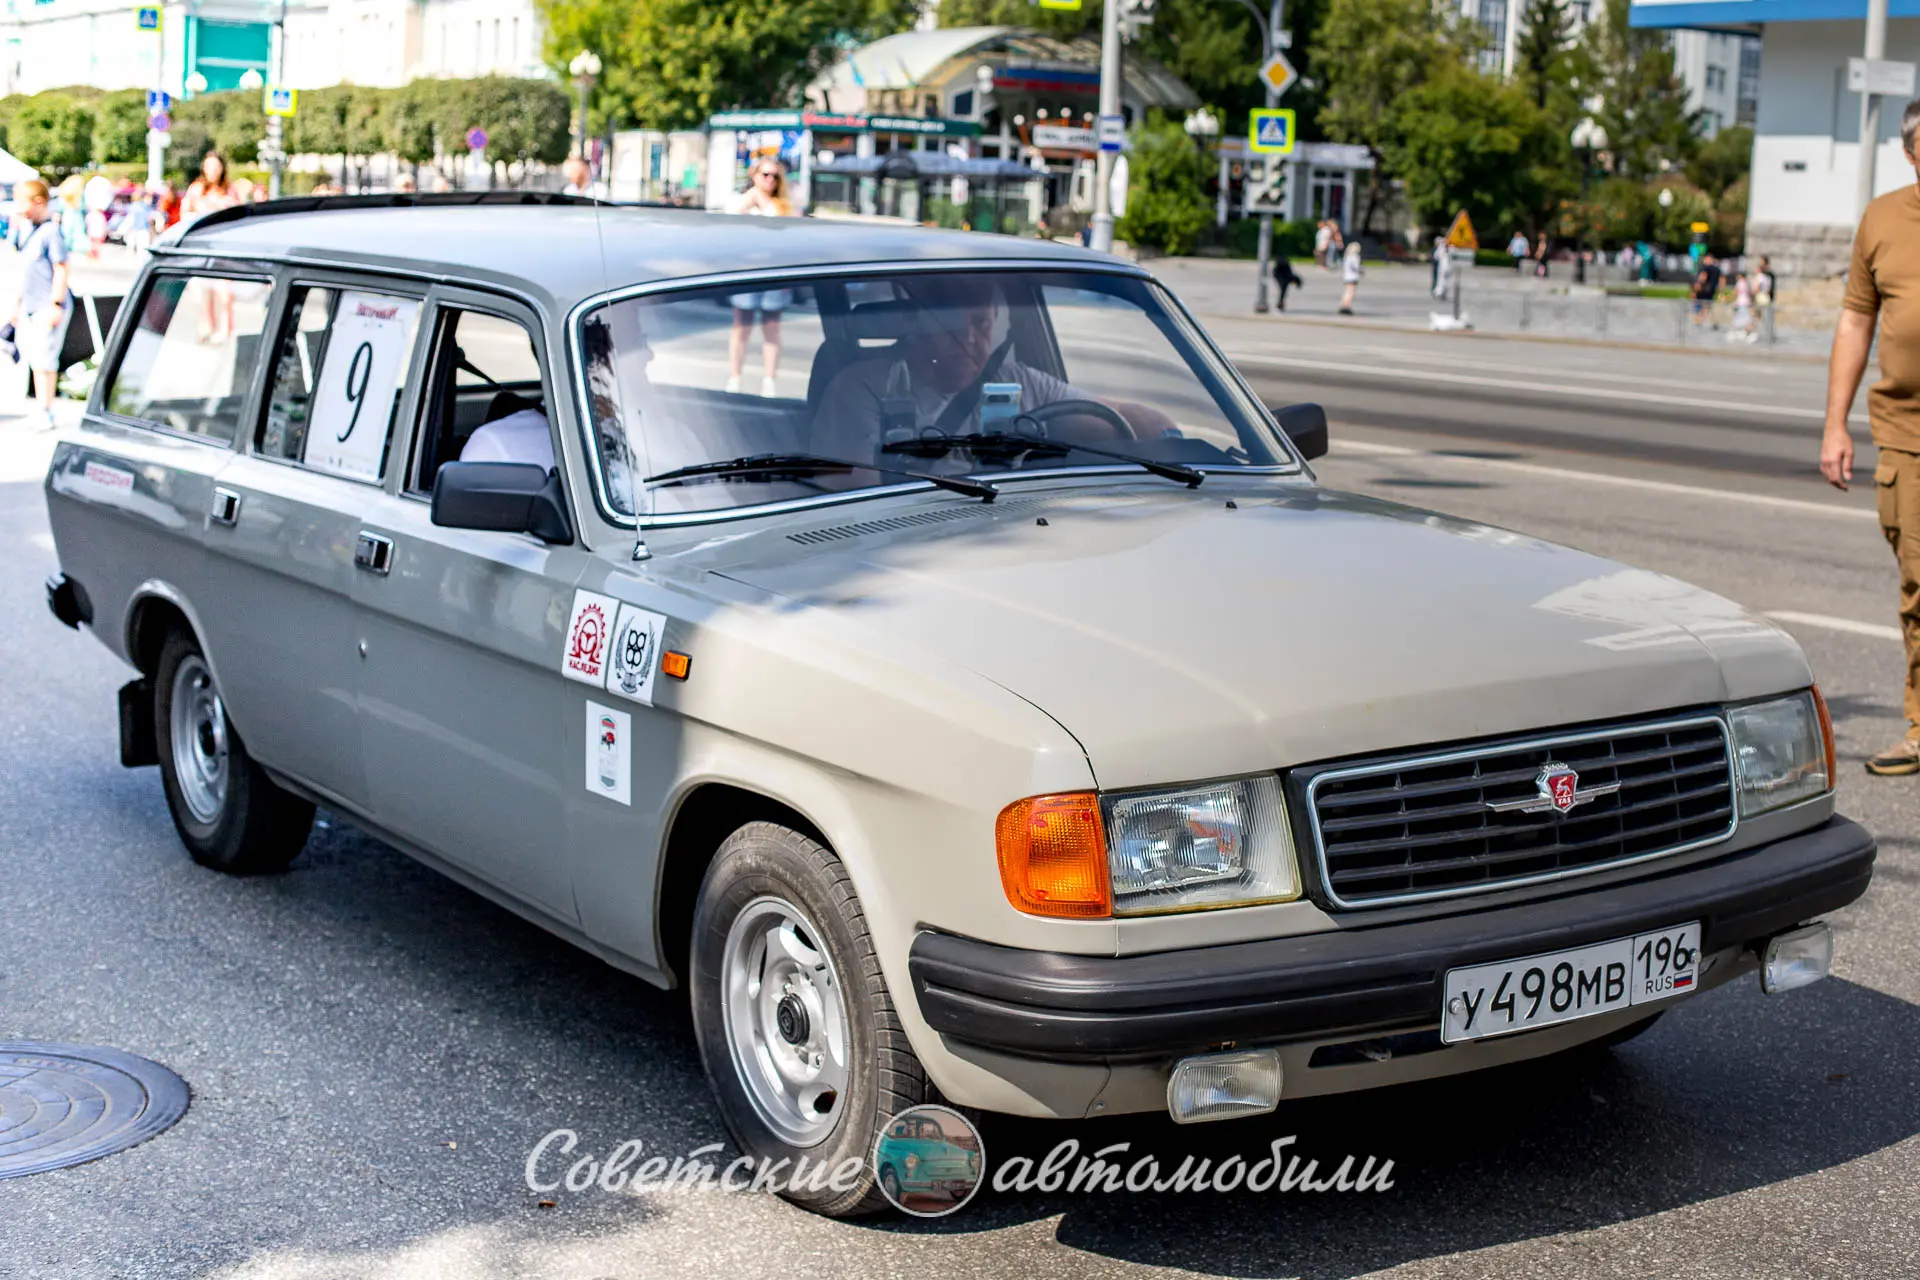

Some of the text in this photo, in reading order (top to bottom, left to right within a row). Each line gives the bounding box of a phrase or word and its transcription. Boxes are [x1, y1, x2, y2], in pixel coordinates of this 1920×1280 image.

[337, 341, 373, 442] 9
[1462, 933, 1690, 1030] У498МВ 196
[1645, 979, 1674, 994] RUS
